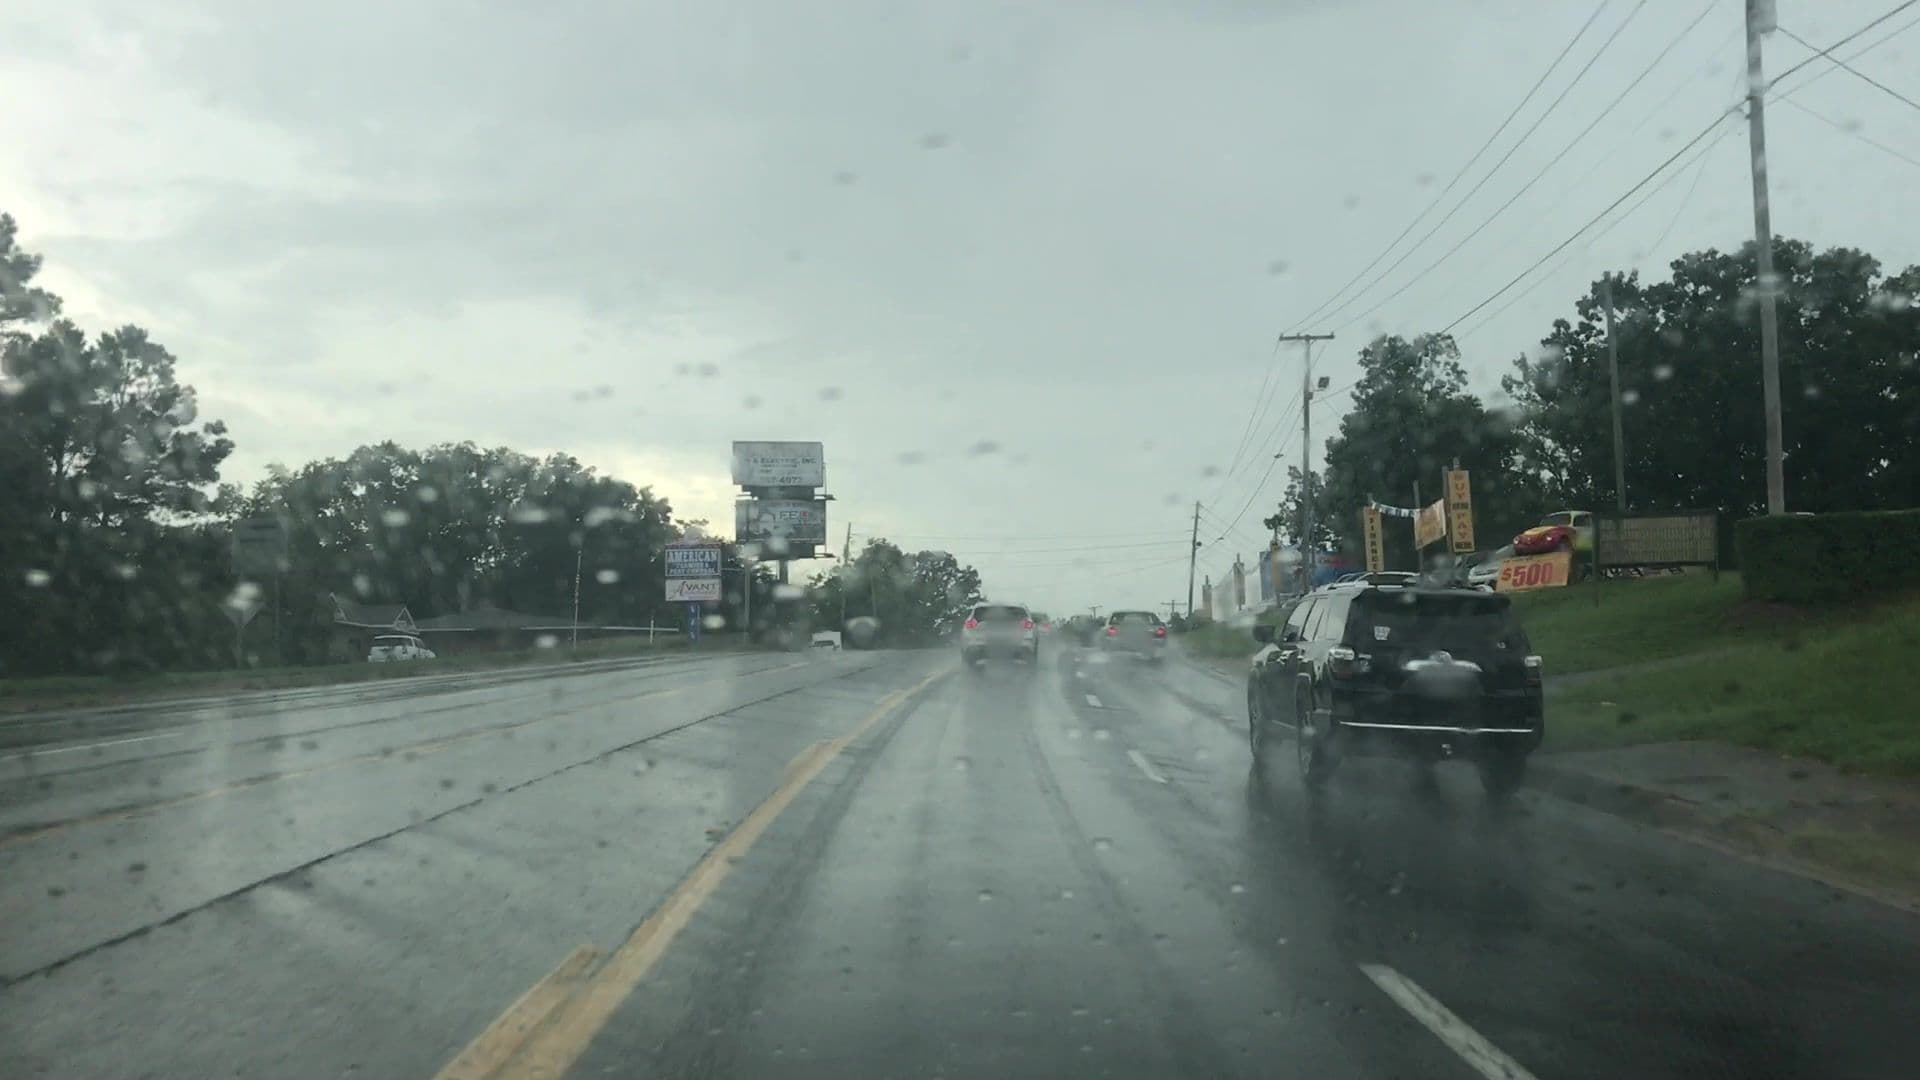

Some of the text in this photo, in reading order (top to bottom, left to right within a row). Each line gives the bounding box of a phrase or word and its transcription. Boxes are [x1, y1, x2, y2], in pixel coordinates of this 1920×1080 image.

[668, 551, 717, 562] AMERICAN
[1501, 562, 1553, 587] $500
[677, 581, 717, 596] AVANT
